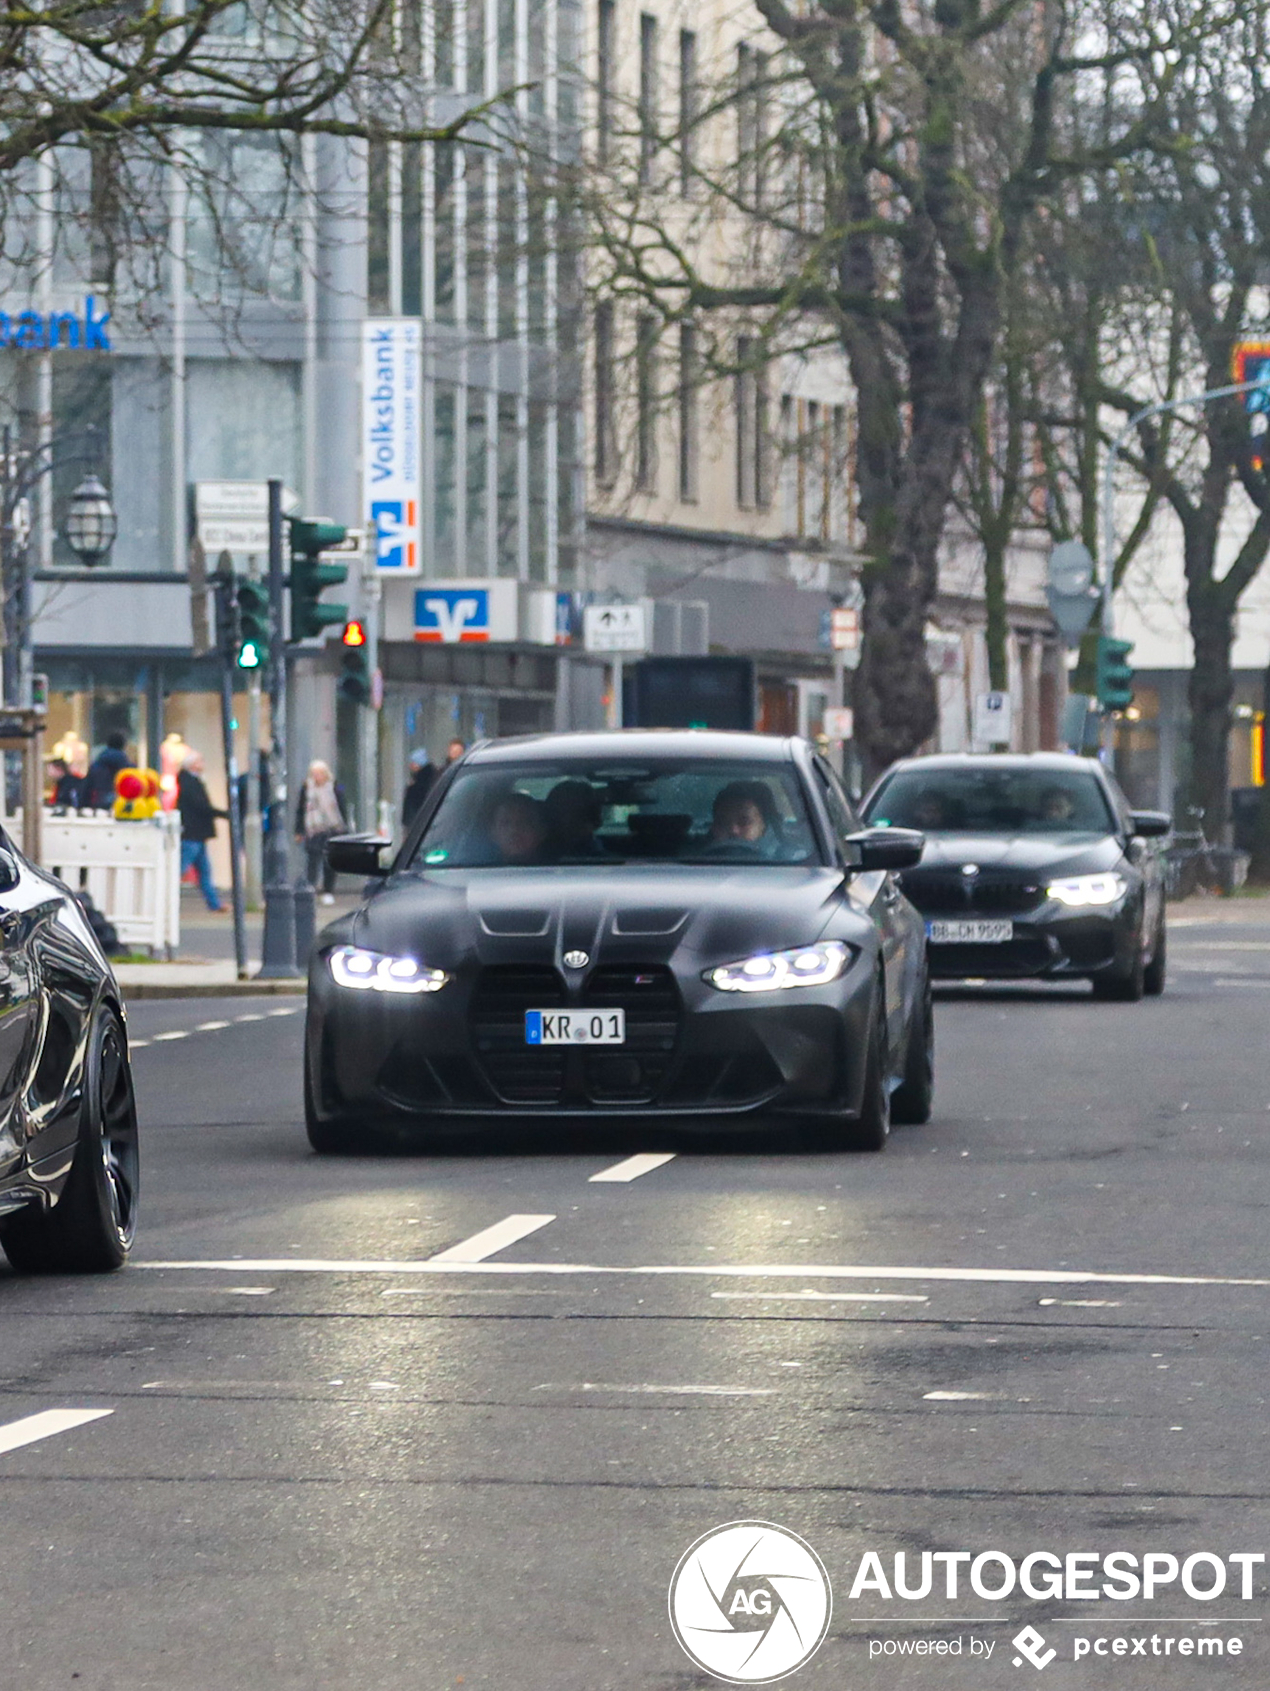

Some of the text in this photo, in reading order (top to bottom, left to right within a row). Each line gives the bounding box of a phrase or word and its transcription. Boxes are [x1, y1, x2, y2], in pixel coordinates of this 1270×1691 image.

[370, 327, 394, 482] Volksbank
[542, 1016, 570, 1039] KR
[590, 1015, 621, 1039] 01
